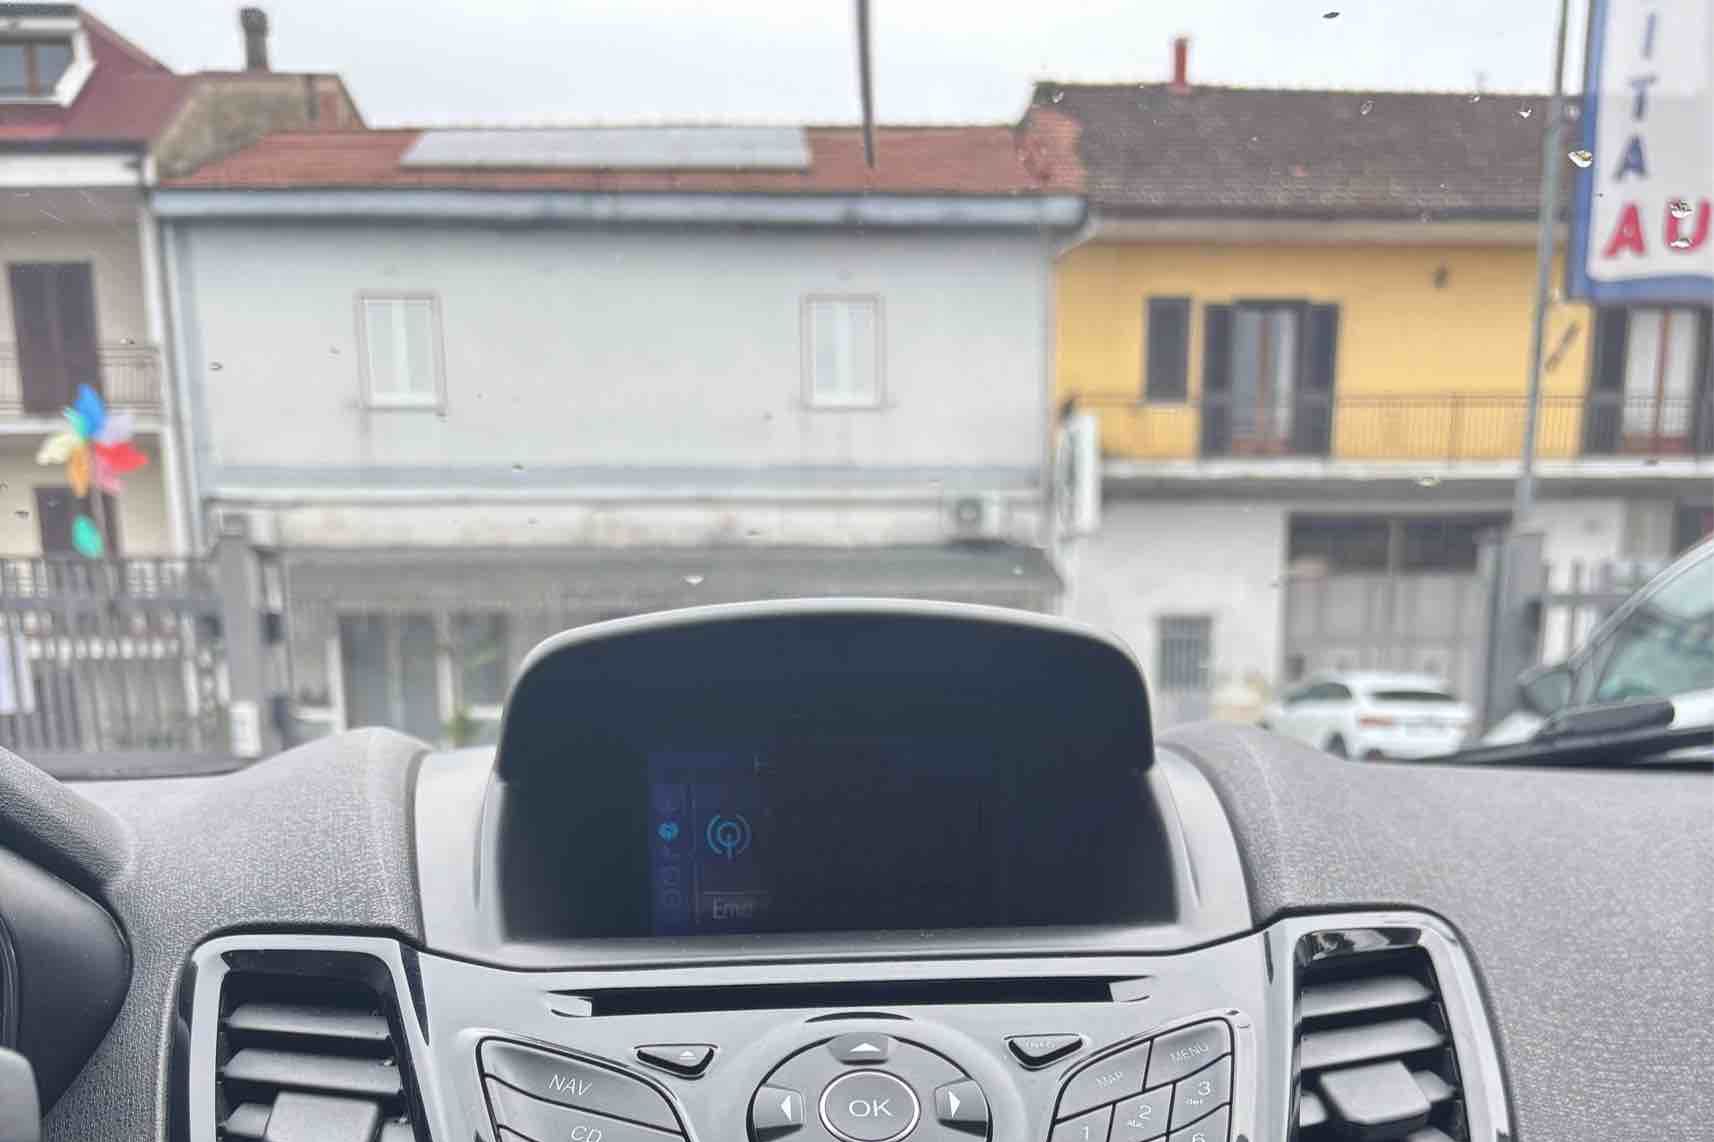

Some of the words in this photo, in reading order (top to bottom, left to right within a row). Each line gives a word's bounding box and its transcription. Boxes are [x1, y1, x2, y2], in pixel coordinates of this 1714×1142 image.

[549, 1074, 592, 1097] NAV
[1198, 1081, 1211, 1096] 3
[849, 1099, 894, 1118] OK
[1138, 1104, 1152, 1120] 2
[1081, 1126, 1089, 1141] 1
